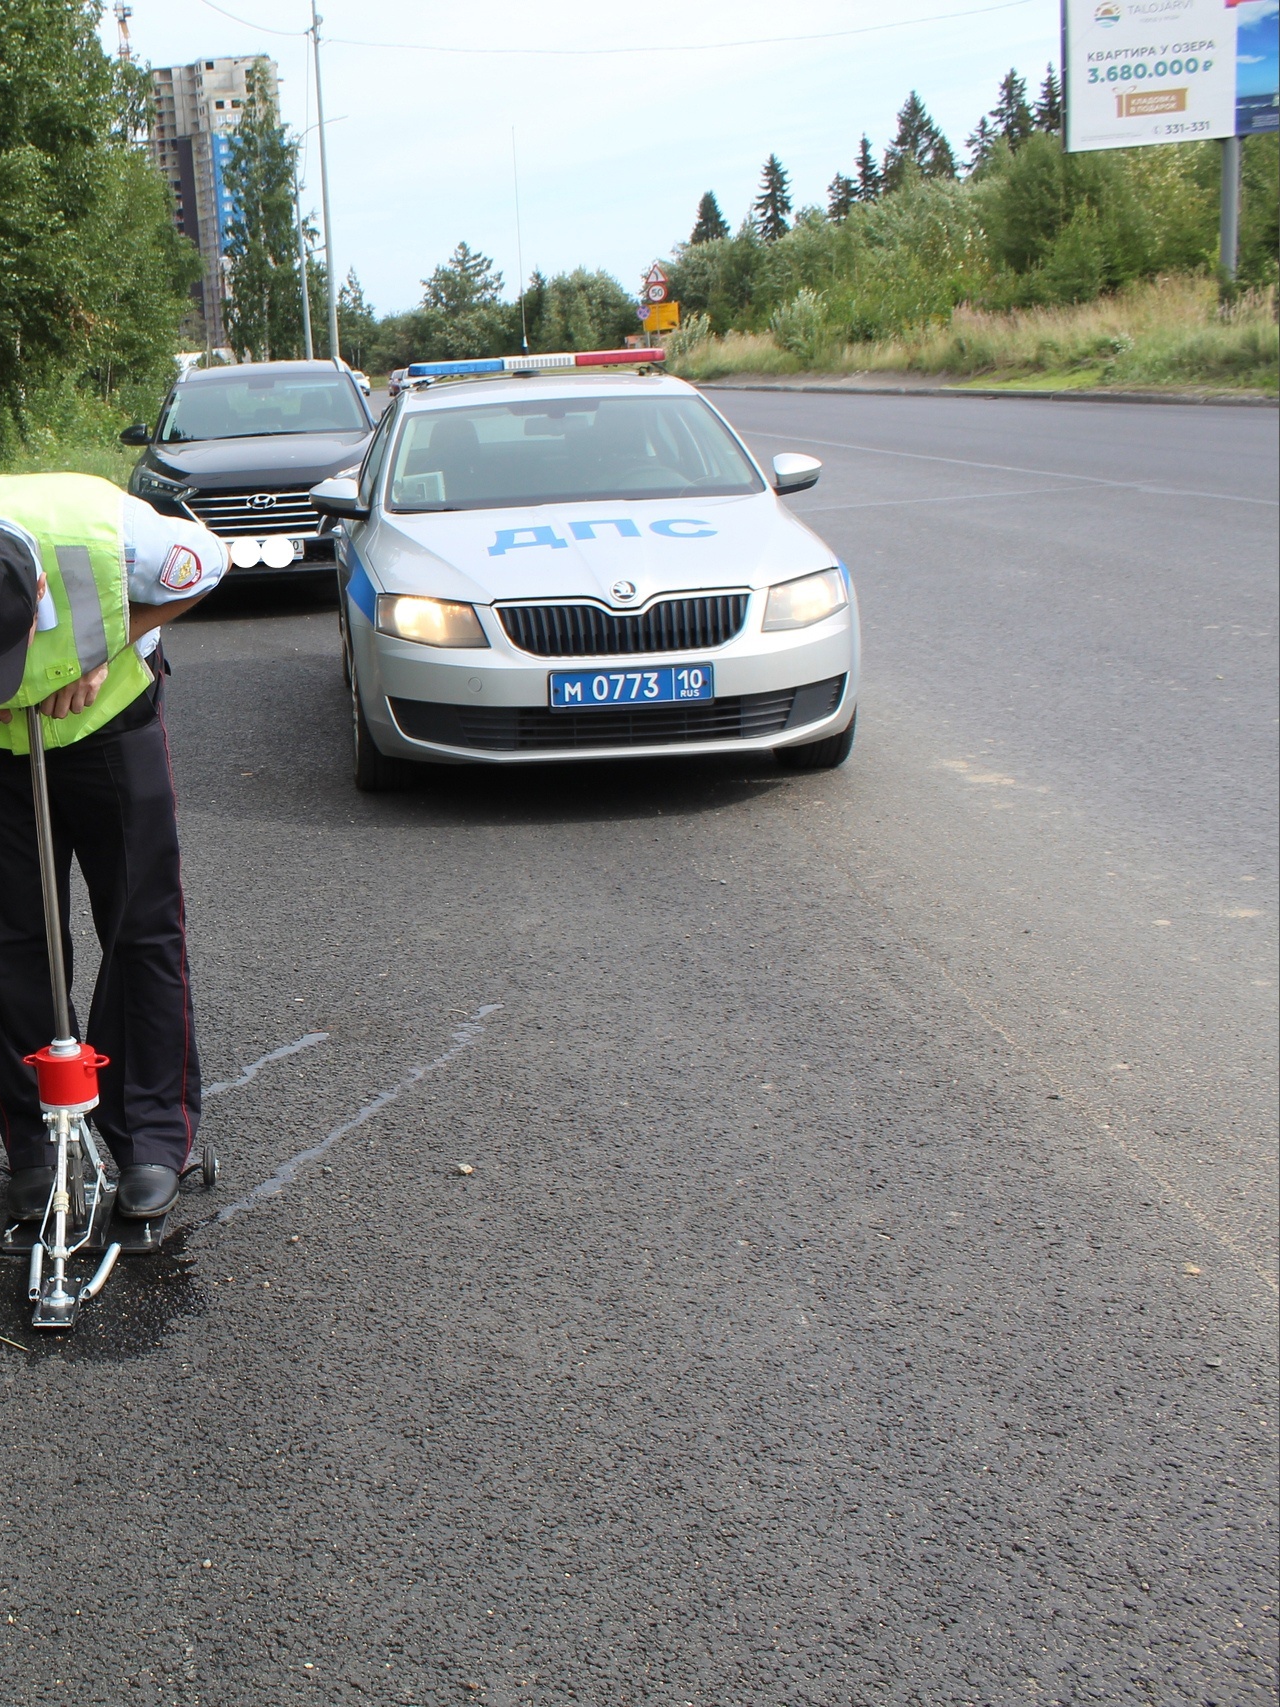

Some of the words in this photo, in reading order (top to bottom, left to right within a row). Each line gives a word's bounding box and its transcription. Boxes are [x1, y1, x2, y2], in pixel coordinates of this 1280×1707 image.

[1087, 46, 1156, 62] КВАРТИРА
[1160, 45, 1169, 56] У
[1171, 40, 1216, 54] ОЗЕРА
[1087, 57, 1199, 84] 3.680.000
[1165, 120, 1210, 135] 331-331
[651, 288, 663, 298] 50
[487, 518, 719, 556] ДПС
[564, 681, 582, 702] М
[592, 672, 659, 701] 0773
[677, 669, 703, 690] 10
[680, 689, 700, 698] RUS
